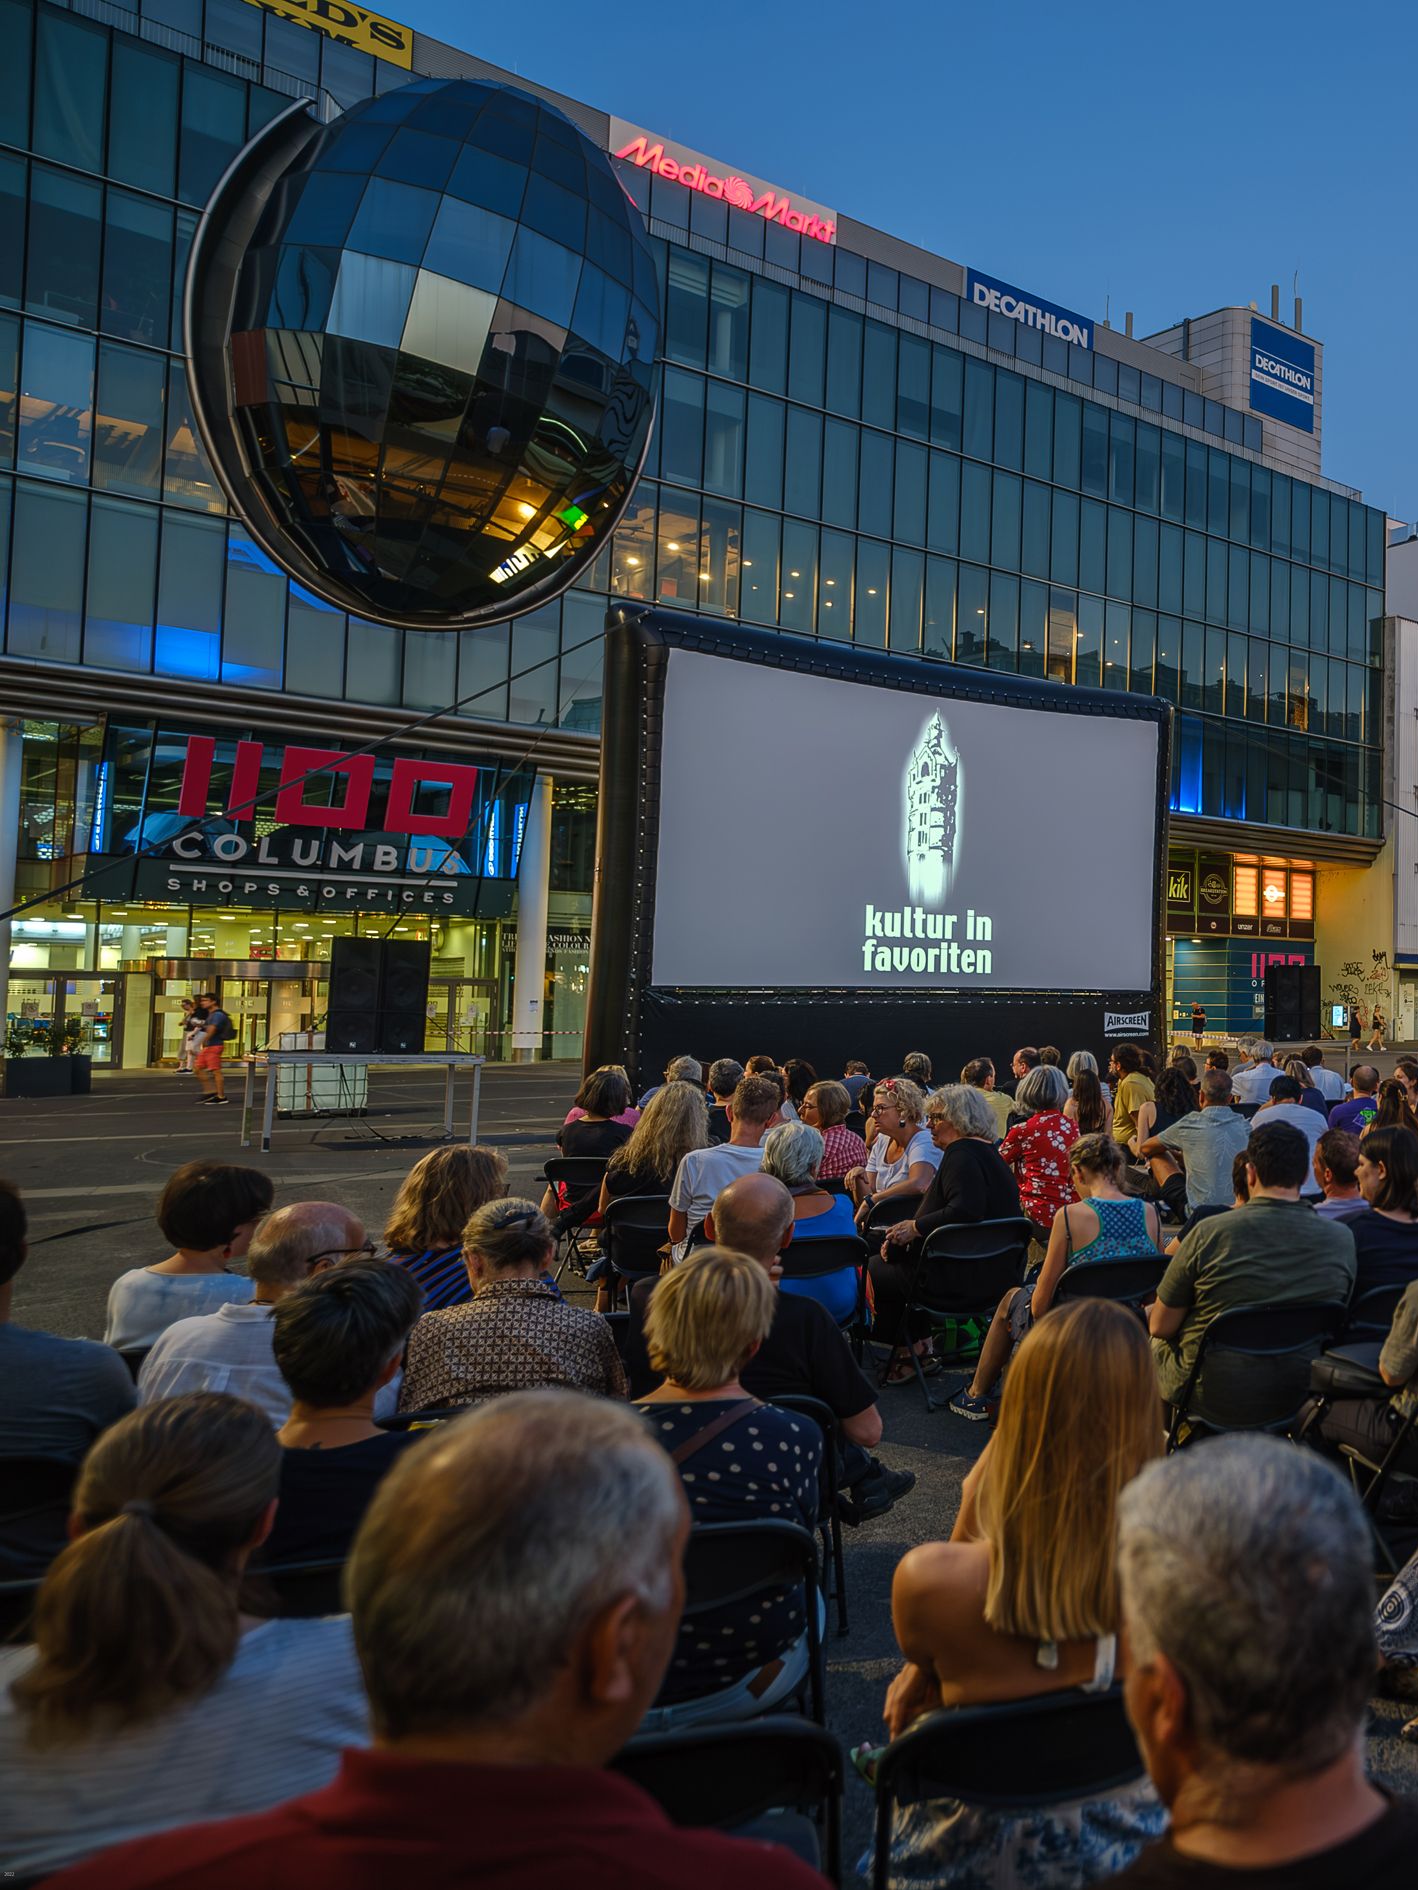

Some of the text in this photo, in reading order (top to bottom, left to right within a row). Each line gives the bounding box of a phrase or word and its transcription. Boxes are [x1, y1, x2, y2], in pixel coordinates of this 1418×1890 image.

[973, 282, 1088, 348] DECATHLON
[1255, 354, 1311, 390] DECATHLON
[178, 736, 477, 838] 1100
[173, 831, 461, 875] COLUMBUS
[167, 879, 454, 904] SHOPS & OFFICES
[1169, 874, 1188, 899] kik
[865, 904, 992, 941] kultur in
[862, 939, 992, 974] favoriten
[1107, 1014, 1147, 1027] AIRSCREEN
